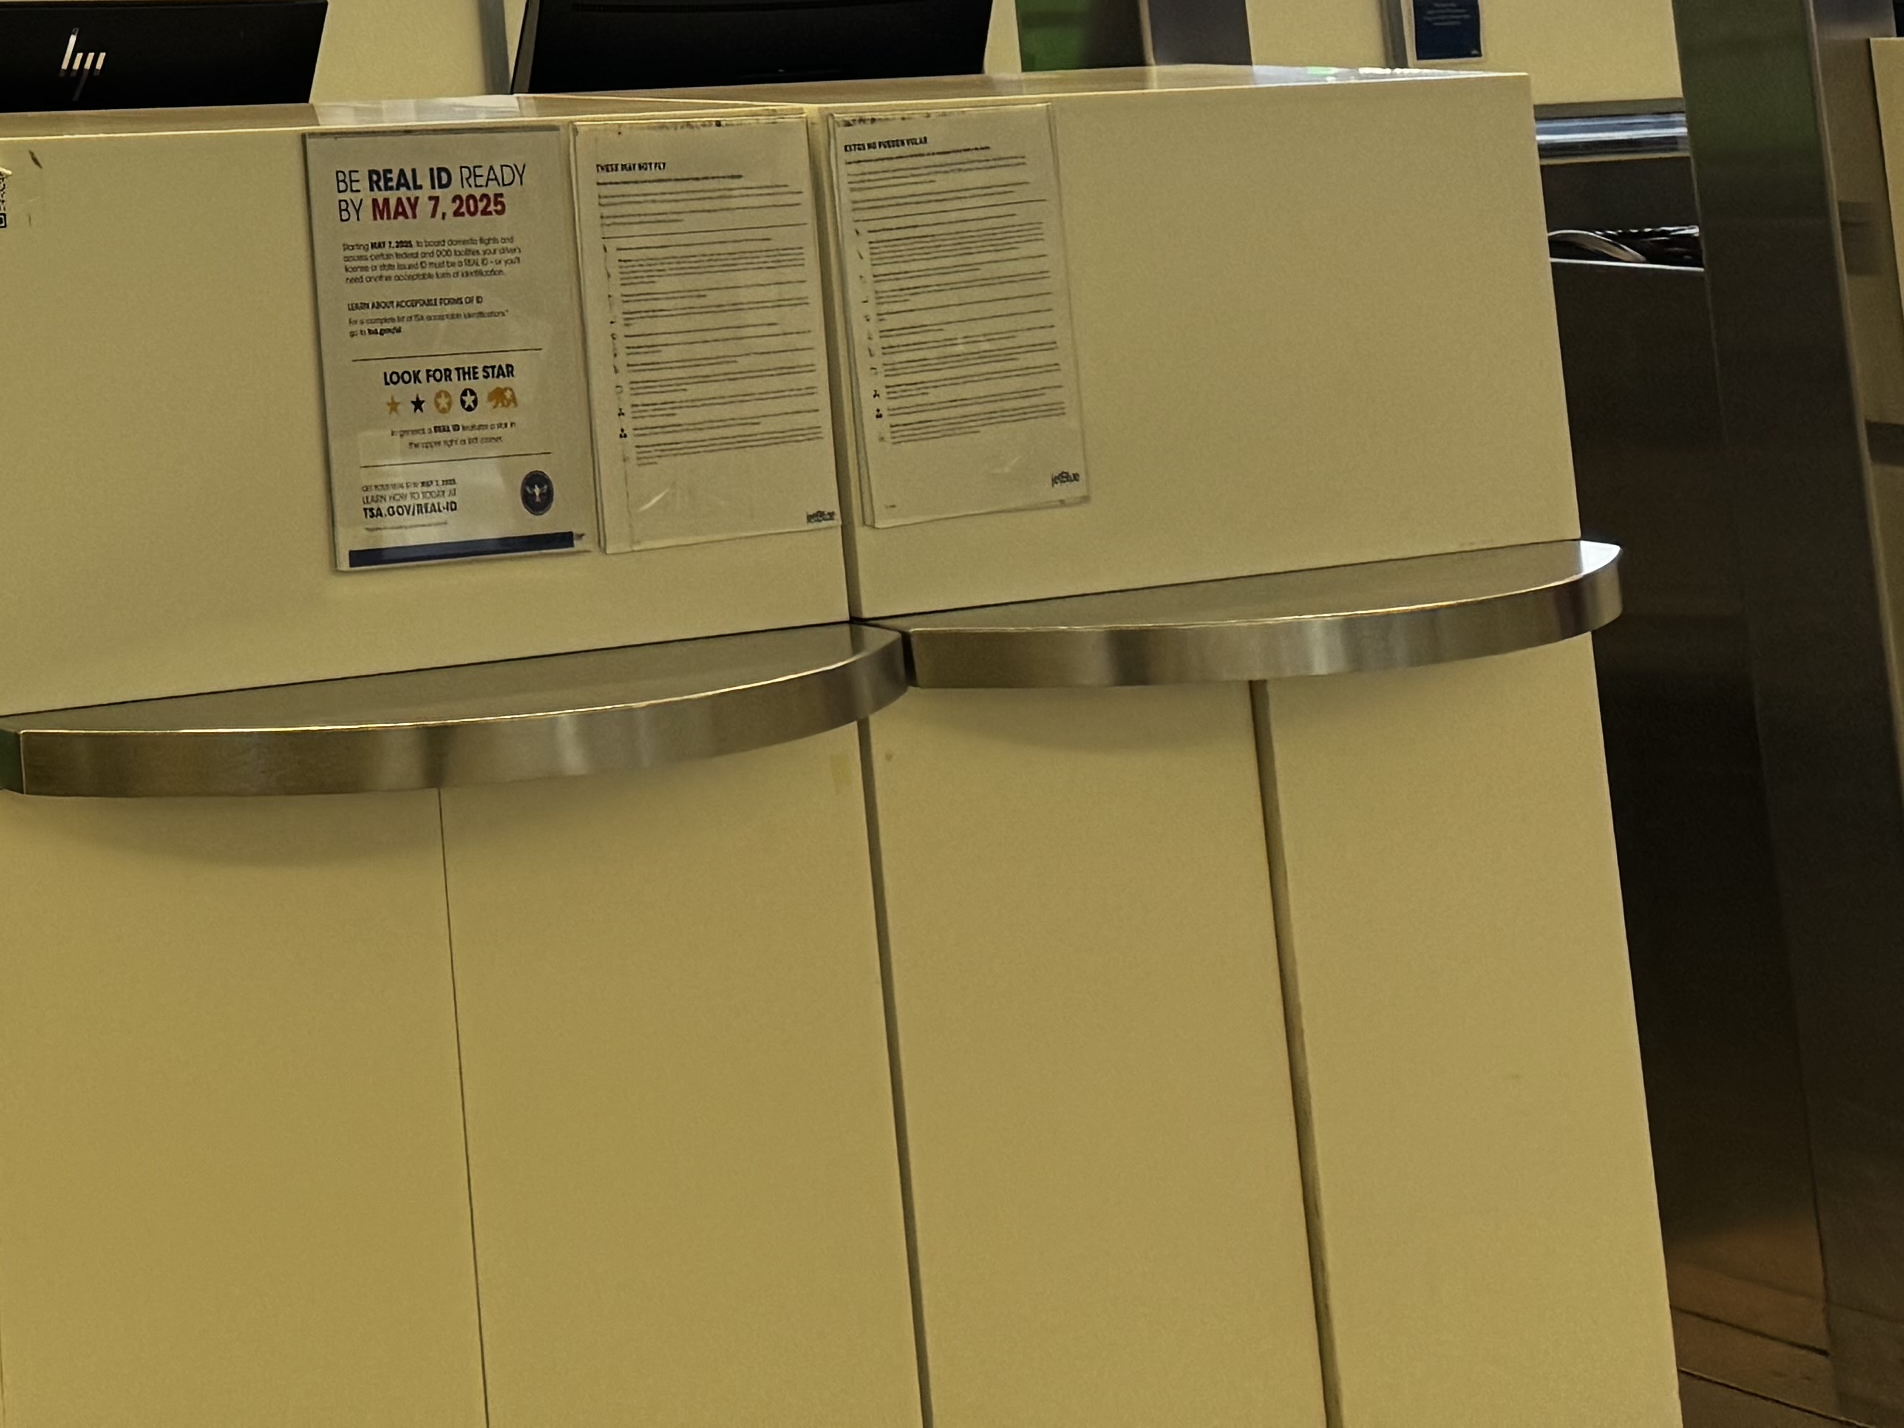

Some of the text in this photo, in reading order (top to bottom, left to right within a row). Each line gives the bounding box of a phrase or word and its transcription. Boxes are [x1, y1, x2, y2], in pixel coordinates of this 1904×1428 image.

[59, 28, 106, 101] hp
[336, 163, 526, 193] BE REAL ID READY
[339, 193, 506, 222] BY MAY 7, 2025
[384, 363, 515, 386] LOOK FOR THE STAR
